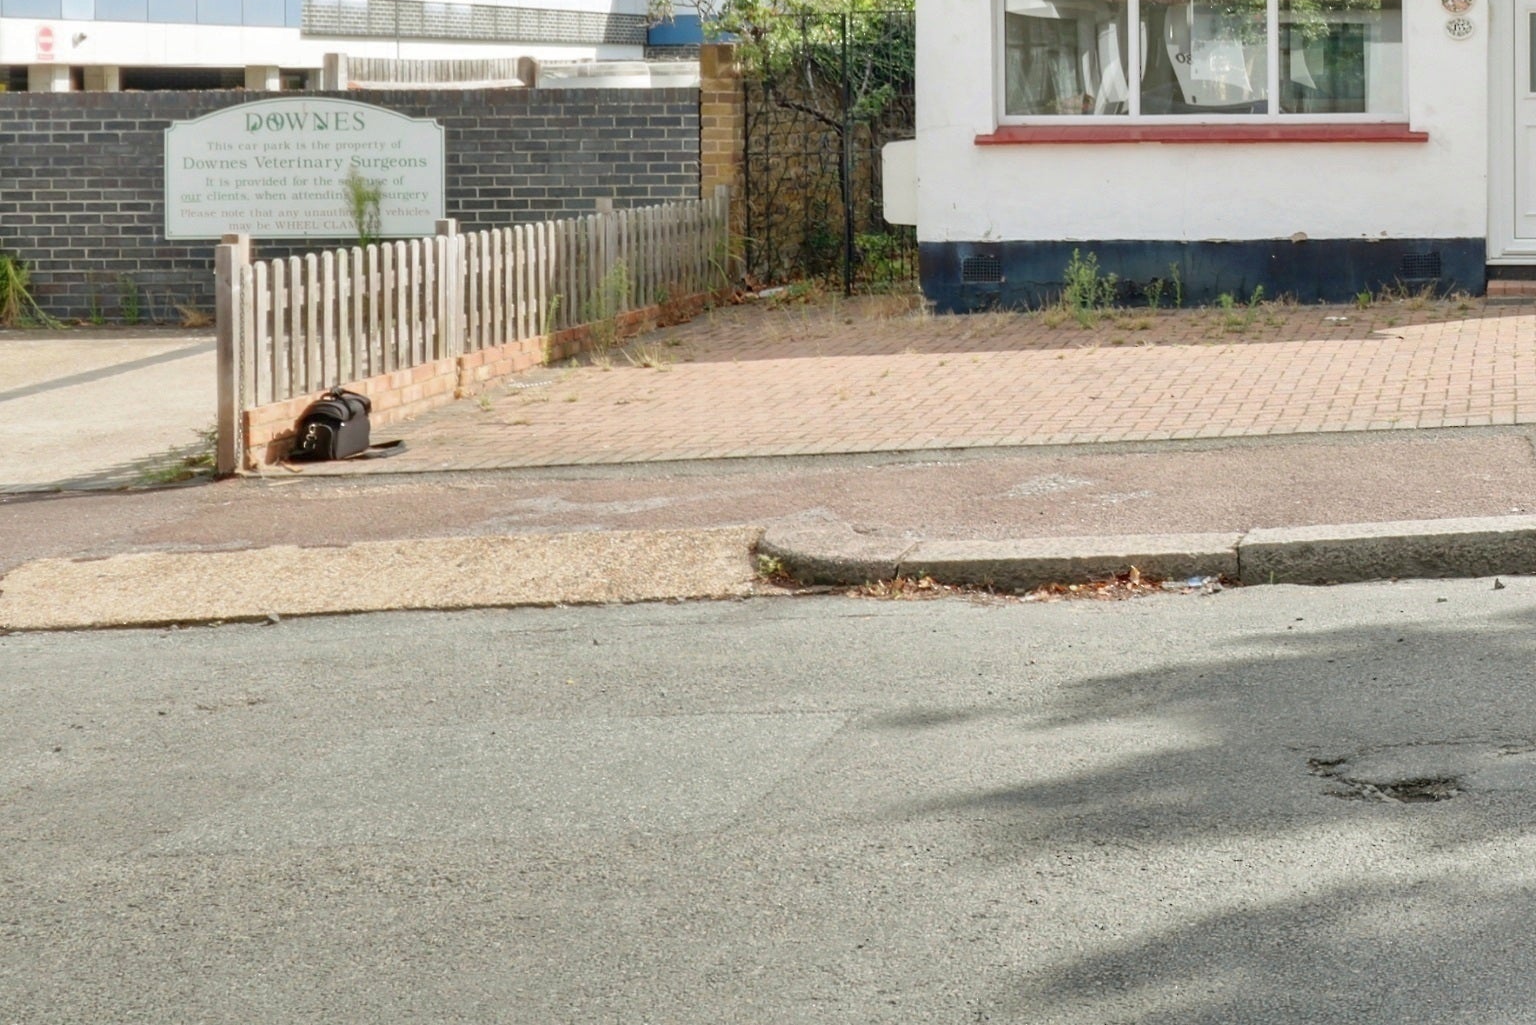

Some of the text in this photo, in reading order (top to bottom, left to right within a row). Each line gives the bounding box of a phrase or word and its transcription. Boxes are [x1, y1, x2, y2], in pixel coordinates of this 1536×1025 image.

[245, 111, 366, 132] DOWNES
[207, 139, 402, 153] This car park is the property of
[183, 154, 428, 172] Downes Veterinary Surgeons
[205, 176, 214, 187] It
[219, 176, 230, 187] is
[235, 175, 287, 190] provided
[292, 175, 308, 186] for
[313, 175, 333, 186] the
[393, 175, 405, 186] of
[180, 192, 202, 203] our
[255, 189, 287, 201] when
[384, 190, 430, 202] surgery
[180, 208, 217, 218] Please
[221, 208, 245, 218] note
[250, 207, 273, 217] that
[278, 208, 300, 219] any
[385, 206, 431, 216] vehicles
[229, 222, 251, 233] may
[257, 220, 270, 231] be
[275, 220, 319, 230] WHEEL
